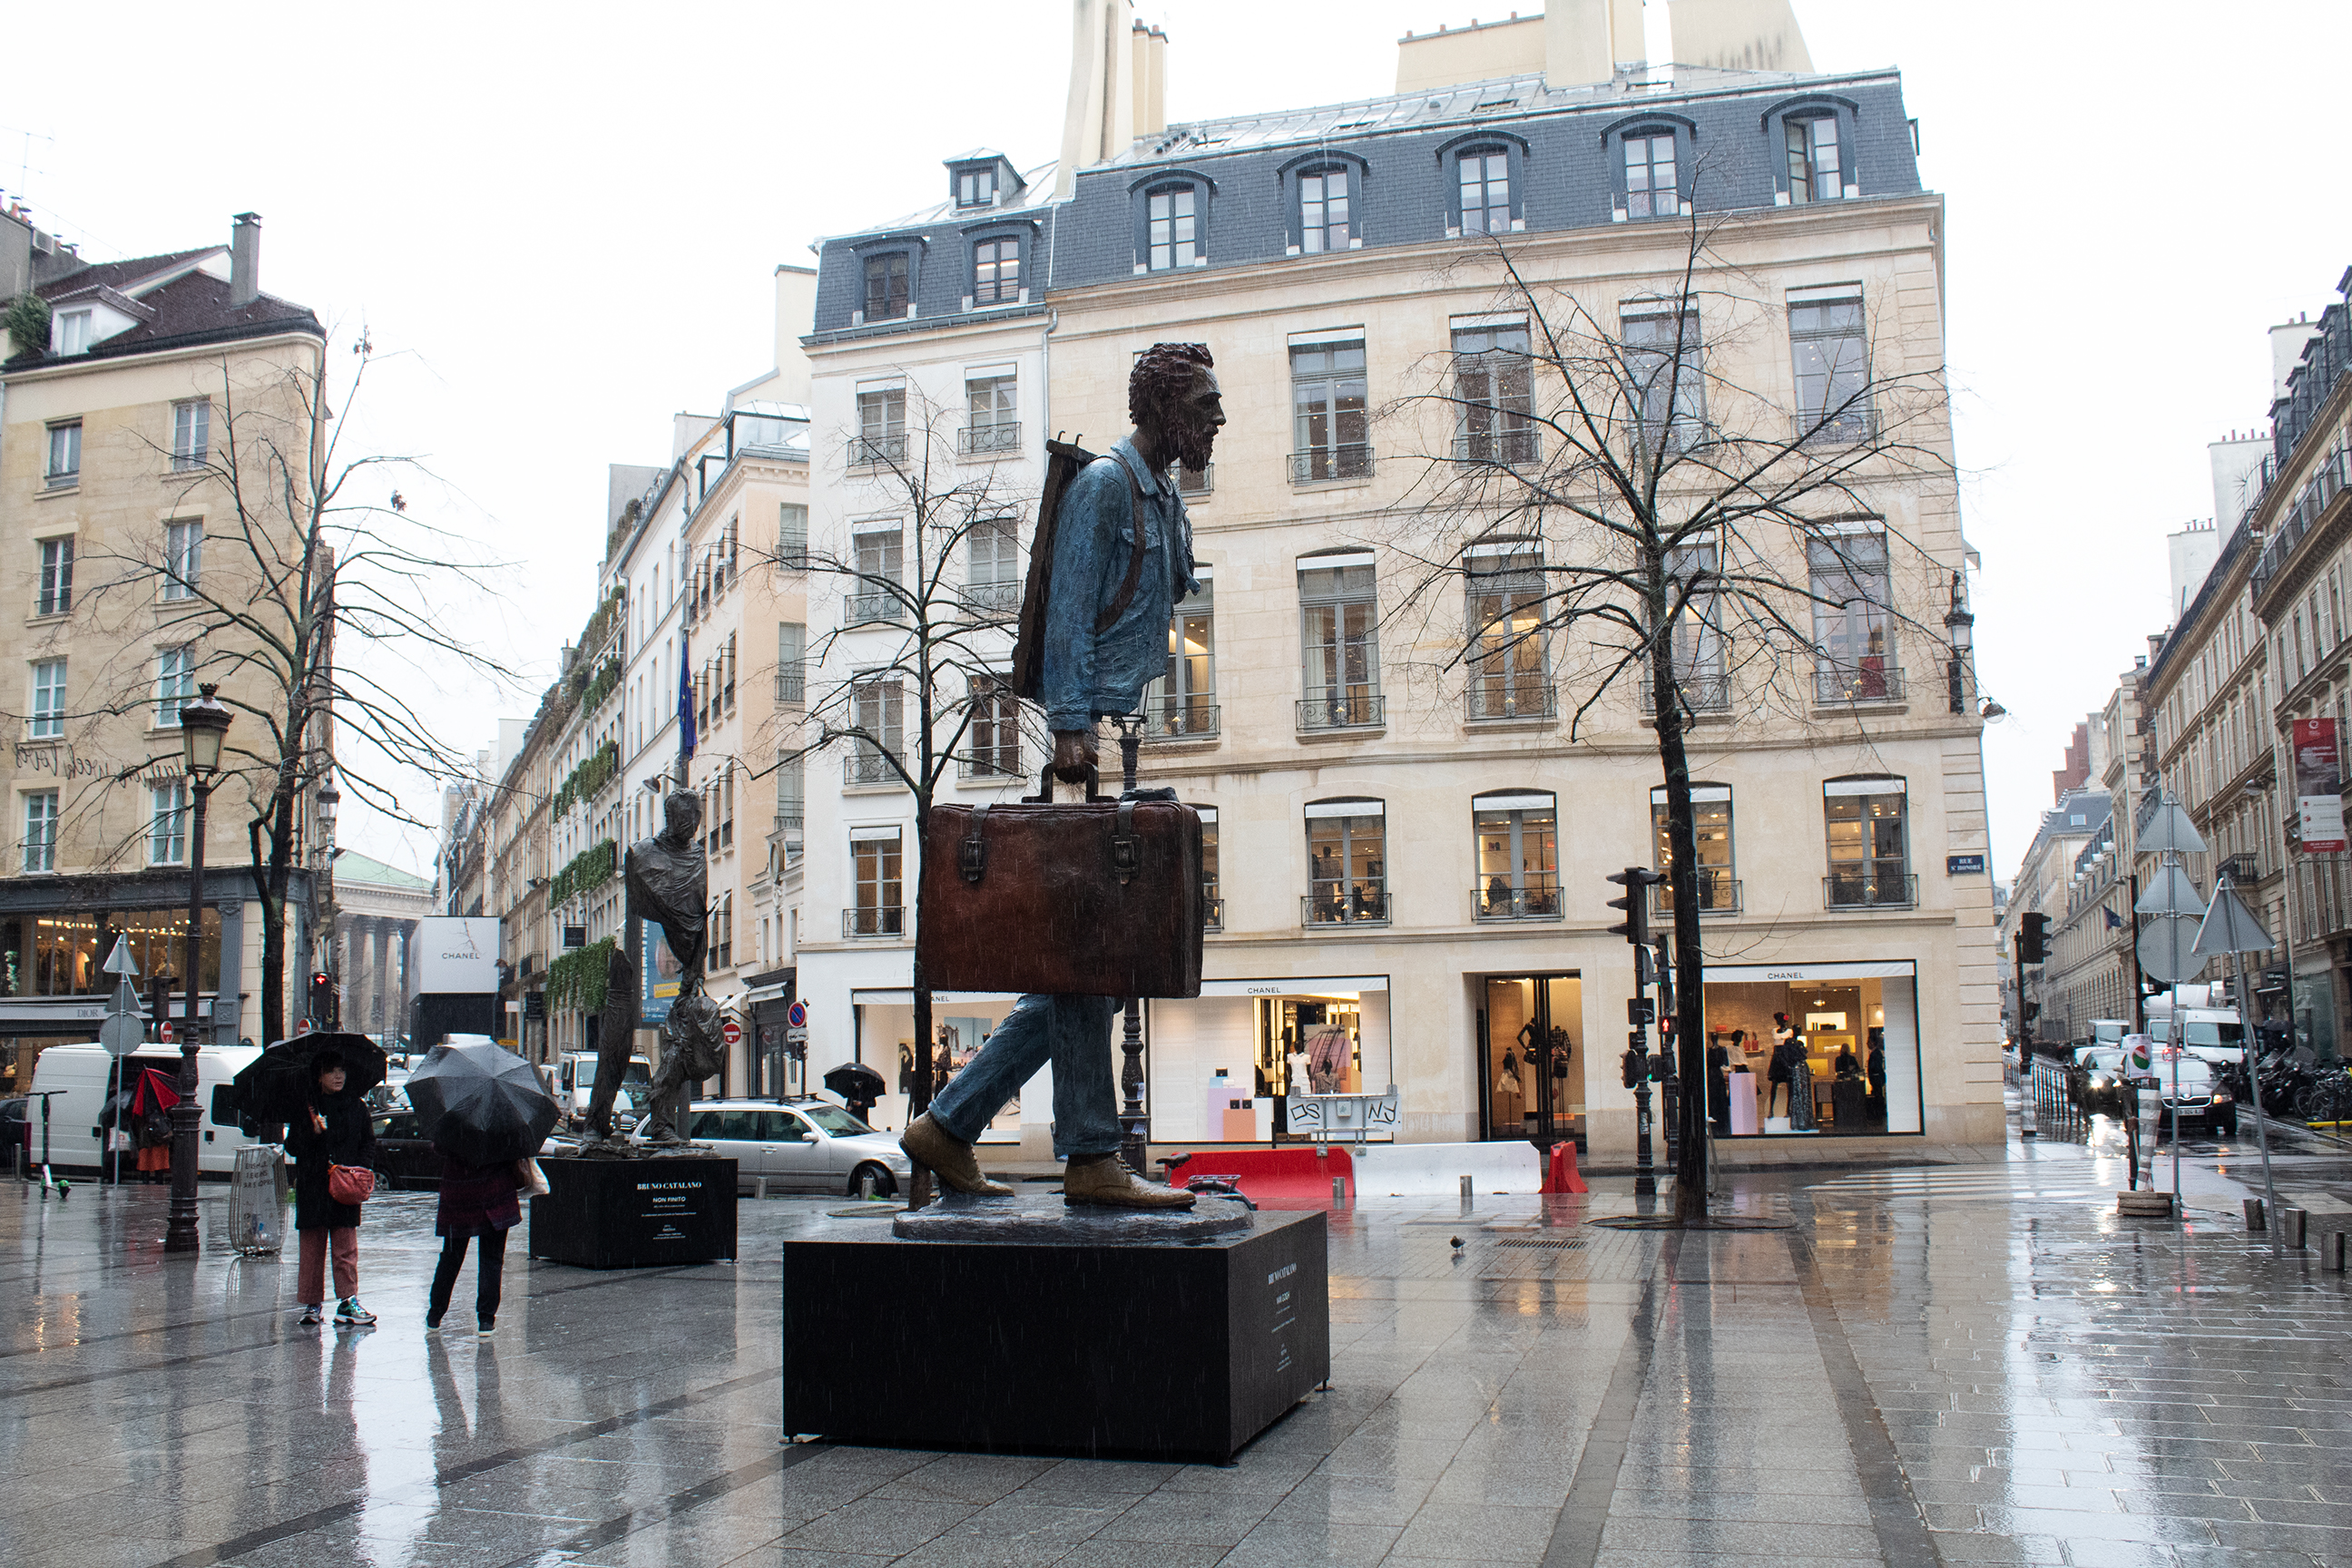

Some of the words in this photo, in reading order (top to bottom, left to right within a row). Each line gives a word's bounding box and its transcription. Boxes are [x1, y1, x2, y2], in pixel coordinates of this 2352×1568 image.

[77, 1008, 99, 1017] DIOR
[636, 1182, 662, 1191] BRUNO
[663, 1181, 702, 1190] CATALANO
